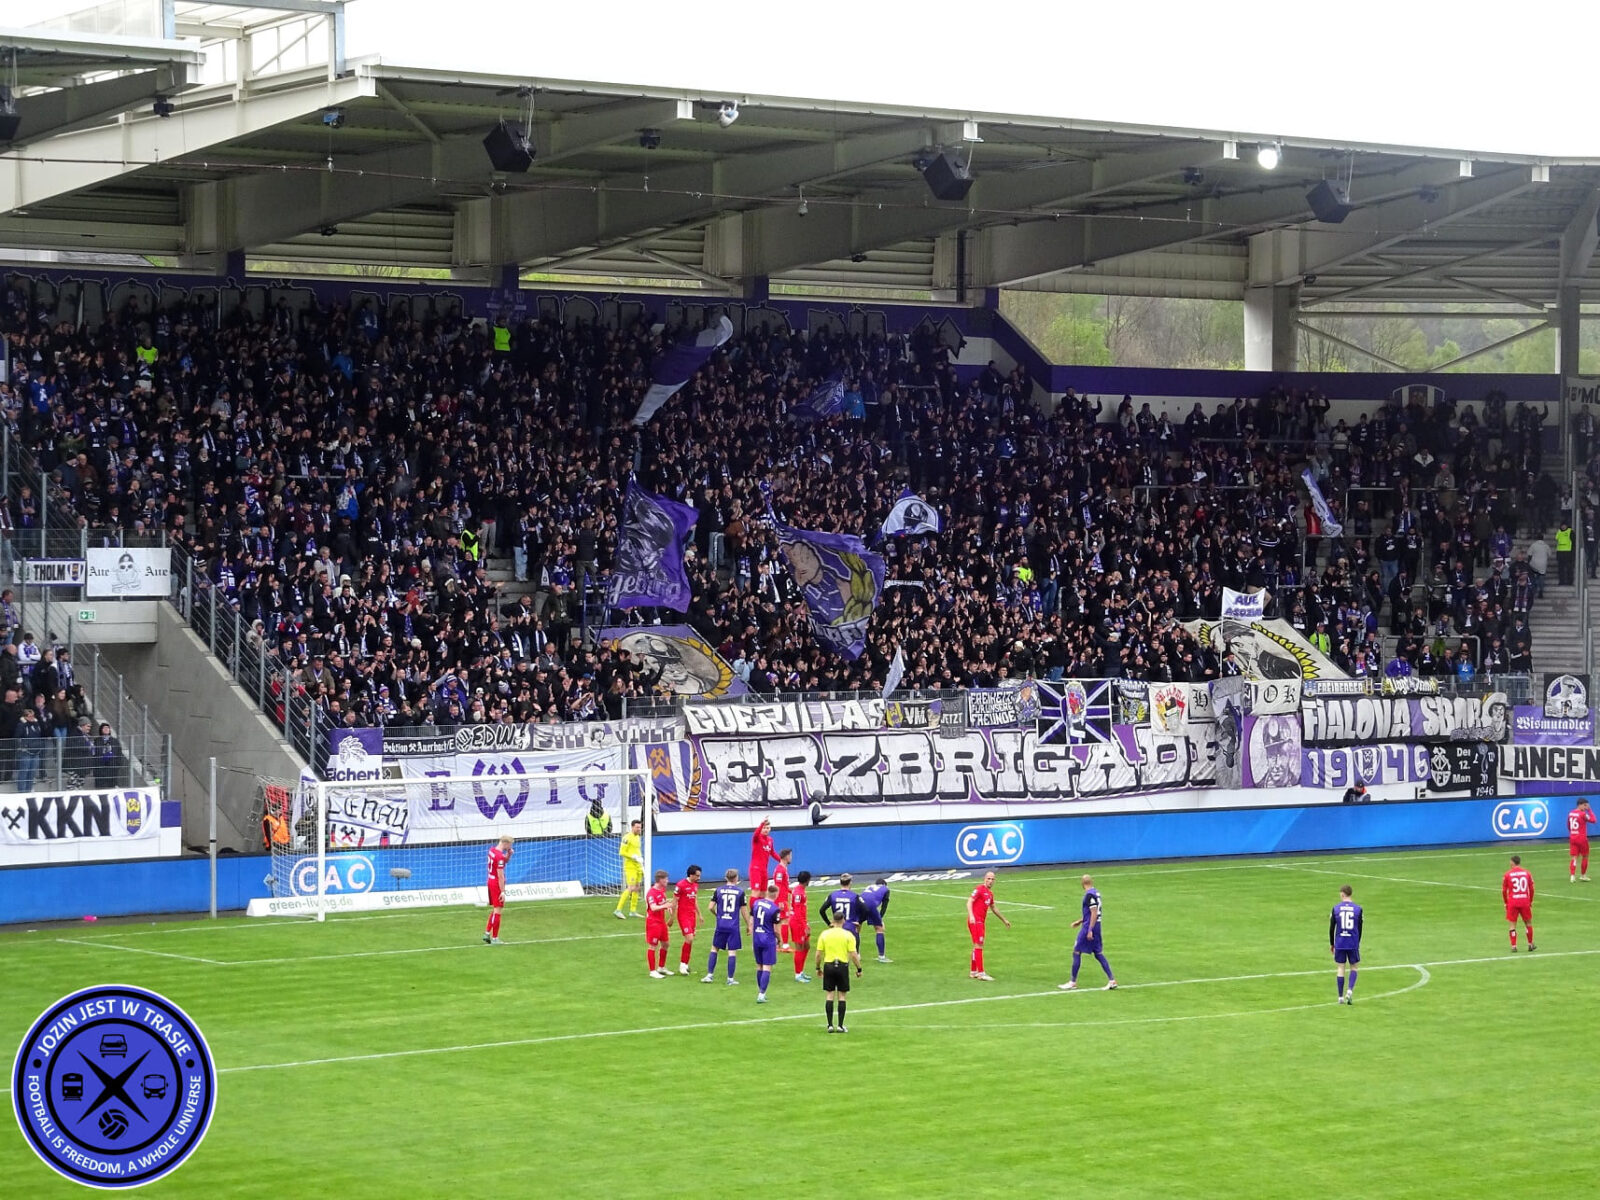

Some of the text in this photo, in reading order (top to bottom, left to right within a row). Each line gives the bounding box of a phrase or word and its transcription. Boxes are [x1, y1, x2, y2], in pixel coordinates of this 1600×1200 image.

[683, 698, 885, 733] GUERILLAS
[1516, 716, 1591, 730] Wismutadler
[27, 796, 112, 839] KKN
[1498, 807, 1544, 830] CAC
[1569, 817, 1579, 830] 16
[962, 830, 1017, 858] CAC
[299, 863, 367, 893] CAC
[1511, 876, 1528, 893] 30
[721, 894, 737, 913] 13
[756, 906, 765, 925] 4
[1339, 911, 1354, 930] 16
